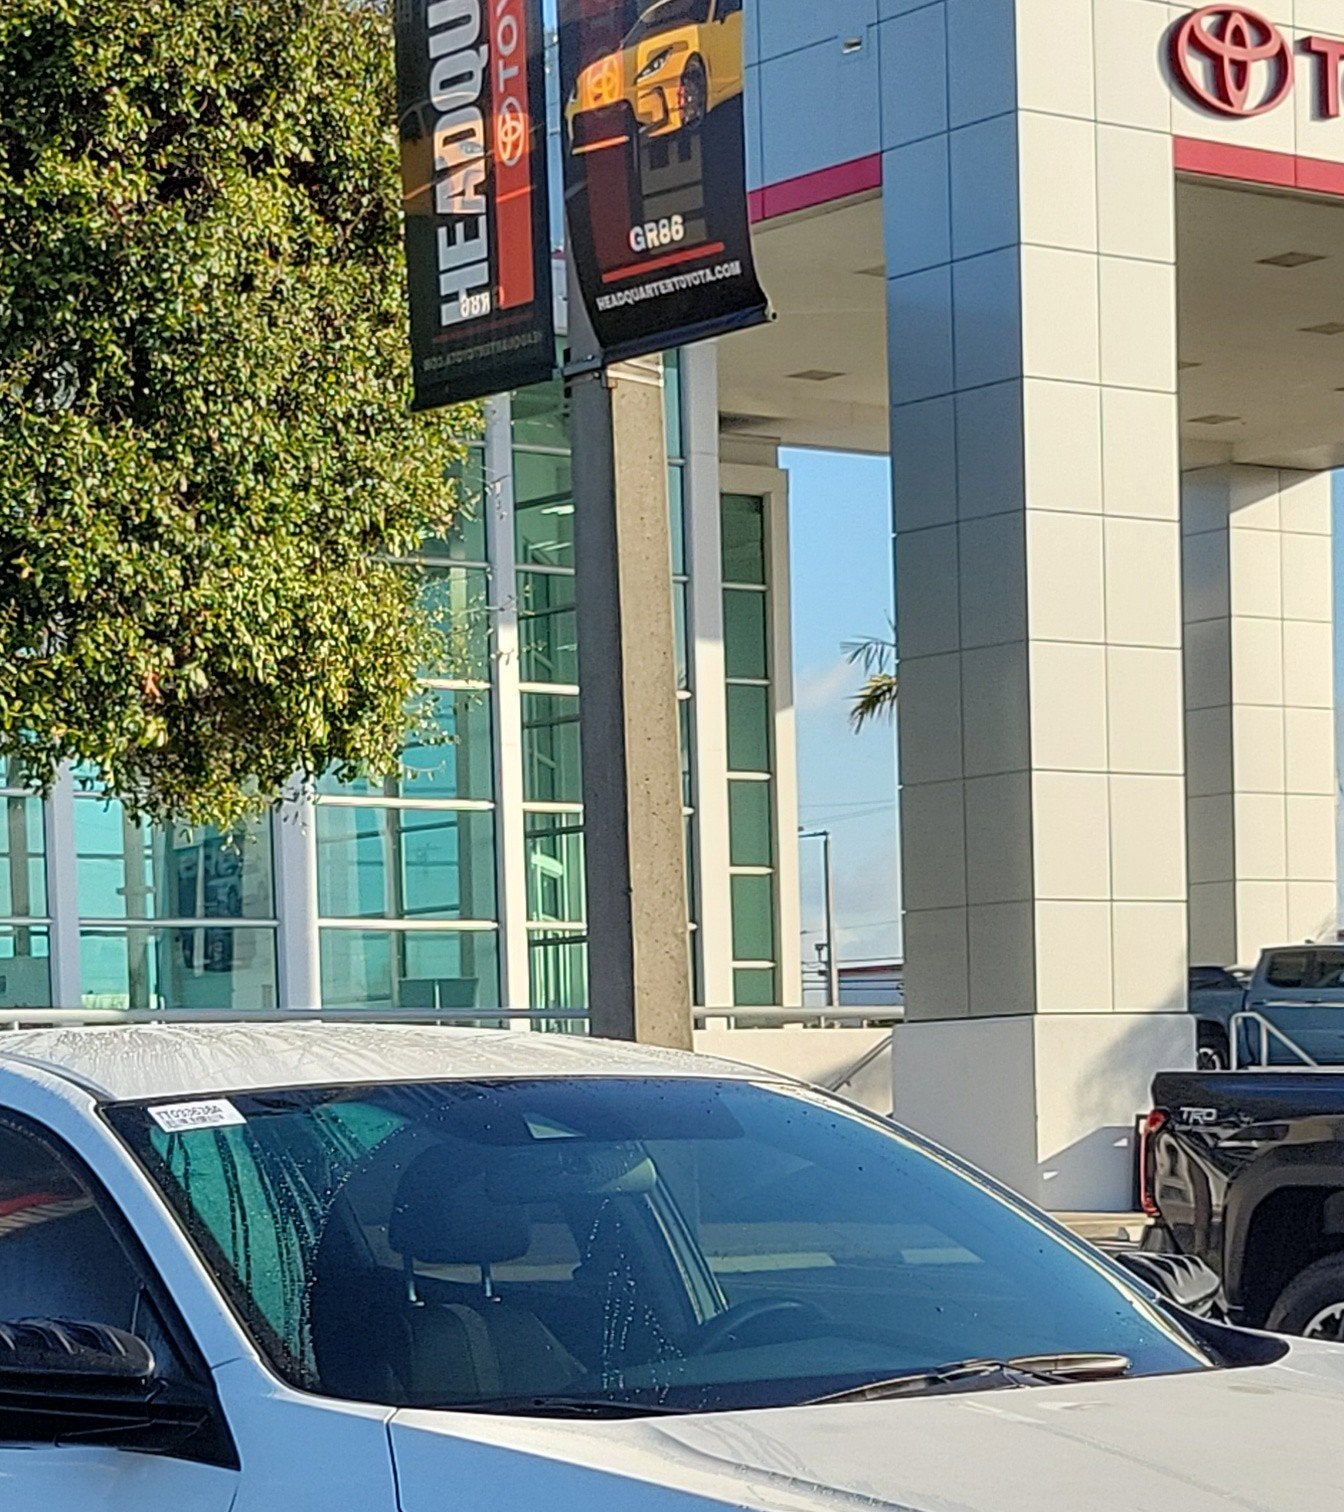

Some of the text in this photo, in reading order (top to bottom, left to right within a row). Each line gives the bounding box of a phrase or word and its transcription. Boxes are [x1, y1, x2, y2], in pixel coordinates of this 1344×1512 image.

[496, 0, 520, 93] TO
[629, 214, 685, 252] GR86
[595, 260, 742, 312] HEADQUARTERTOYOTA.COM
[1179, 1106, 1217, 1125] TRD
